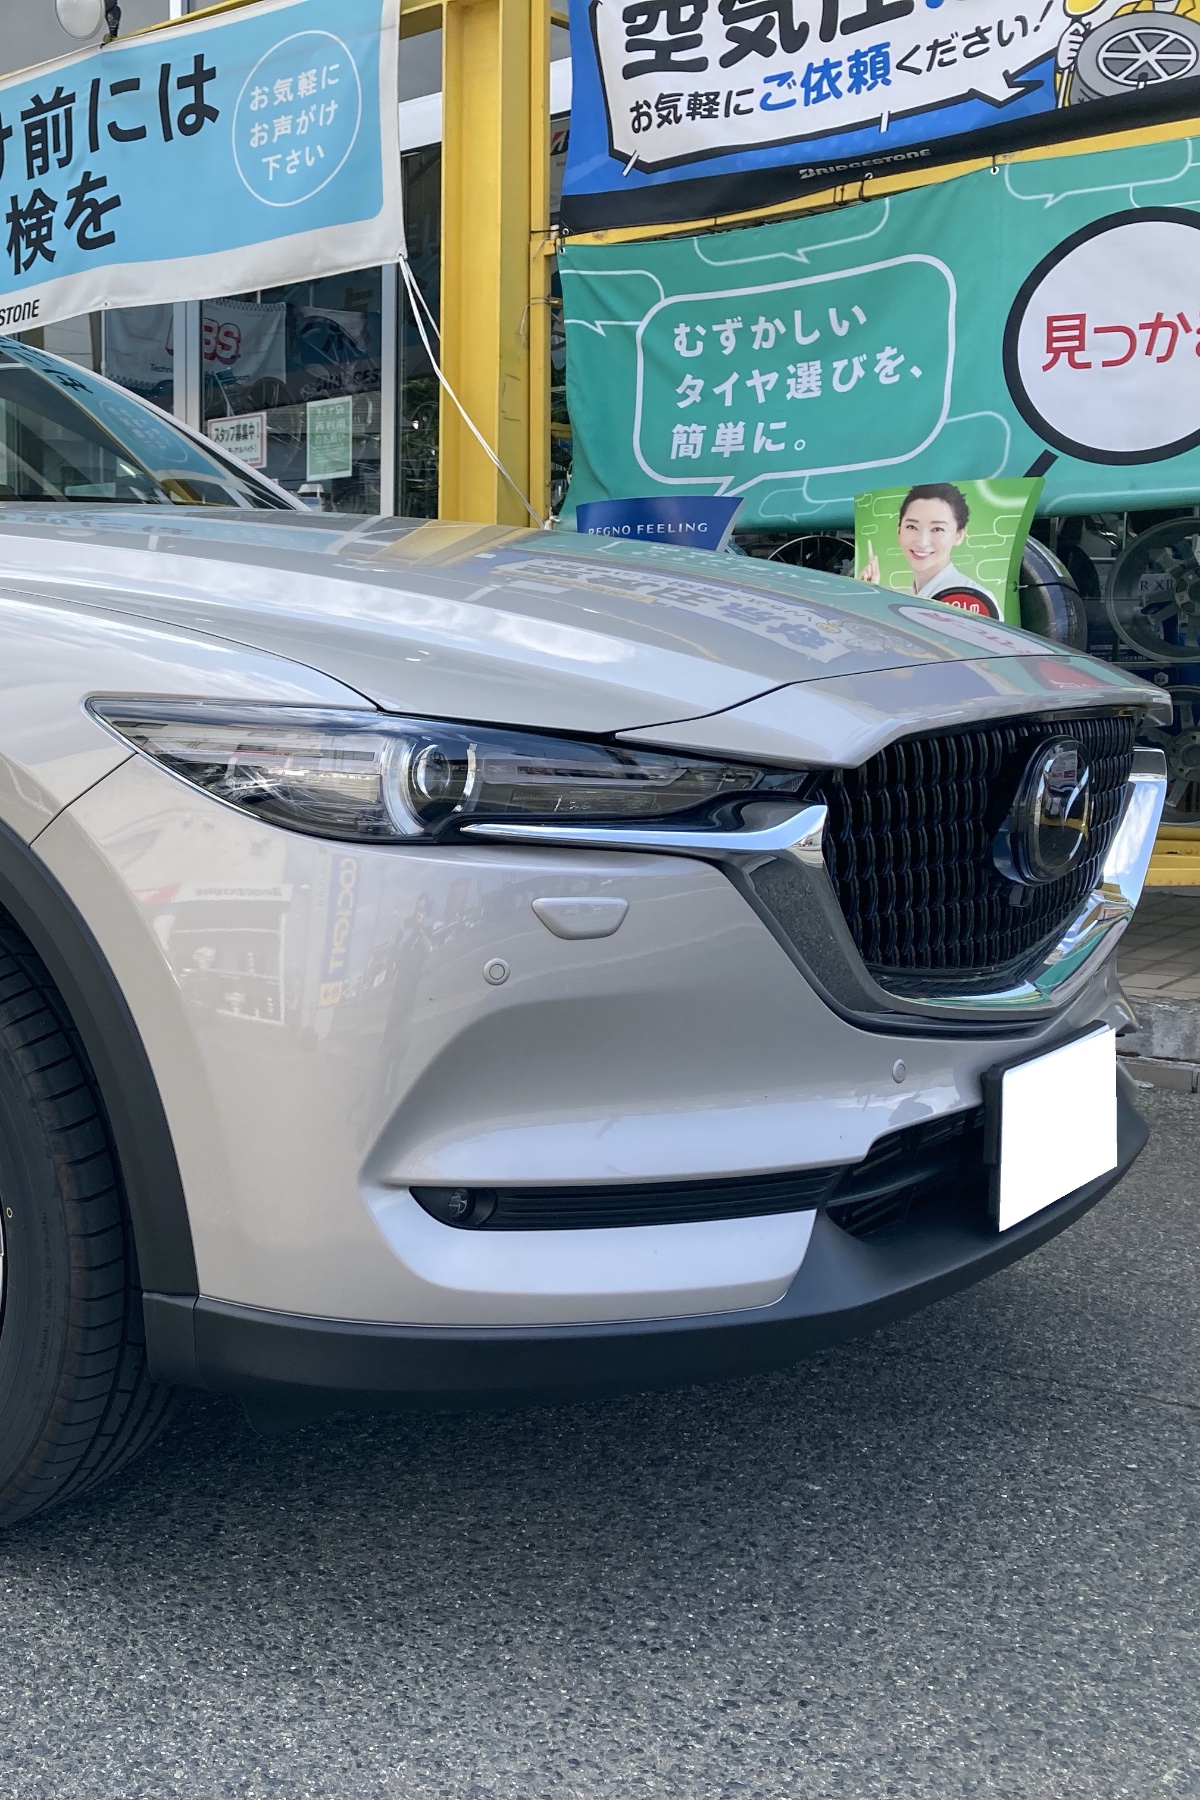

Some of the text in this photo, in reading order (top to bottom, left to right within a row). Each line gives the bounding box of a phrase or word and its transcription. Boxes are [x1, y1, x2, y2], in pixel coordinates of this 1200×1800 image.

[250, 63, 340, 111] お気軽に
[630, 0, 1054, 134] お気軽にご依頼ください!
[250, 99, 339, 148] お声がけ
[261, 144, 325, 181] 下さい
[798, 148, 932, 180] BRIDGESTONE
[673, 304, 868, 358] むずかしい
[675, 345, 924, 410] タイヤ選びを、
[670, 419, 807, 461] 簡単に。
[636, 522, 709, 535] FEELING
